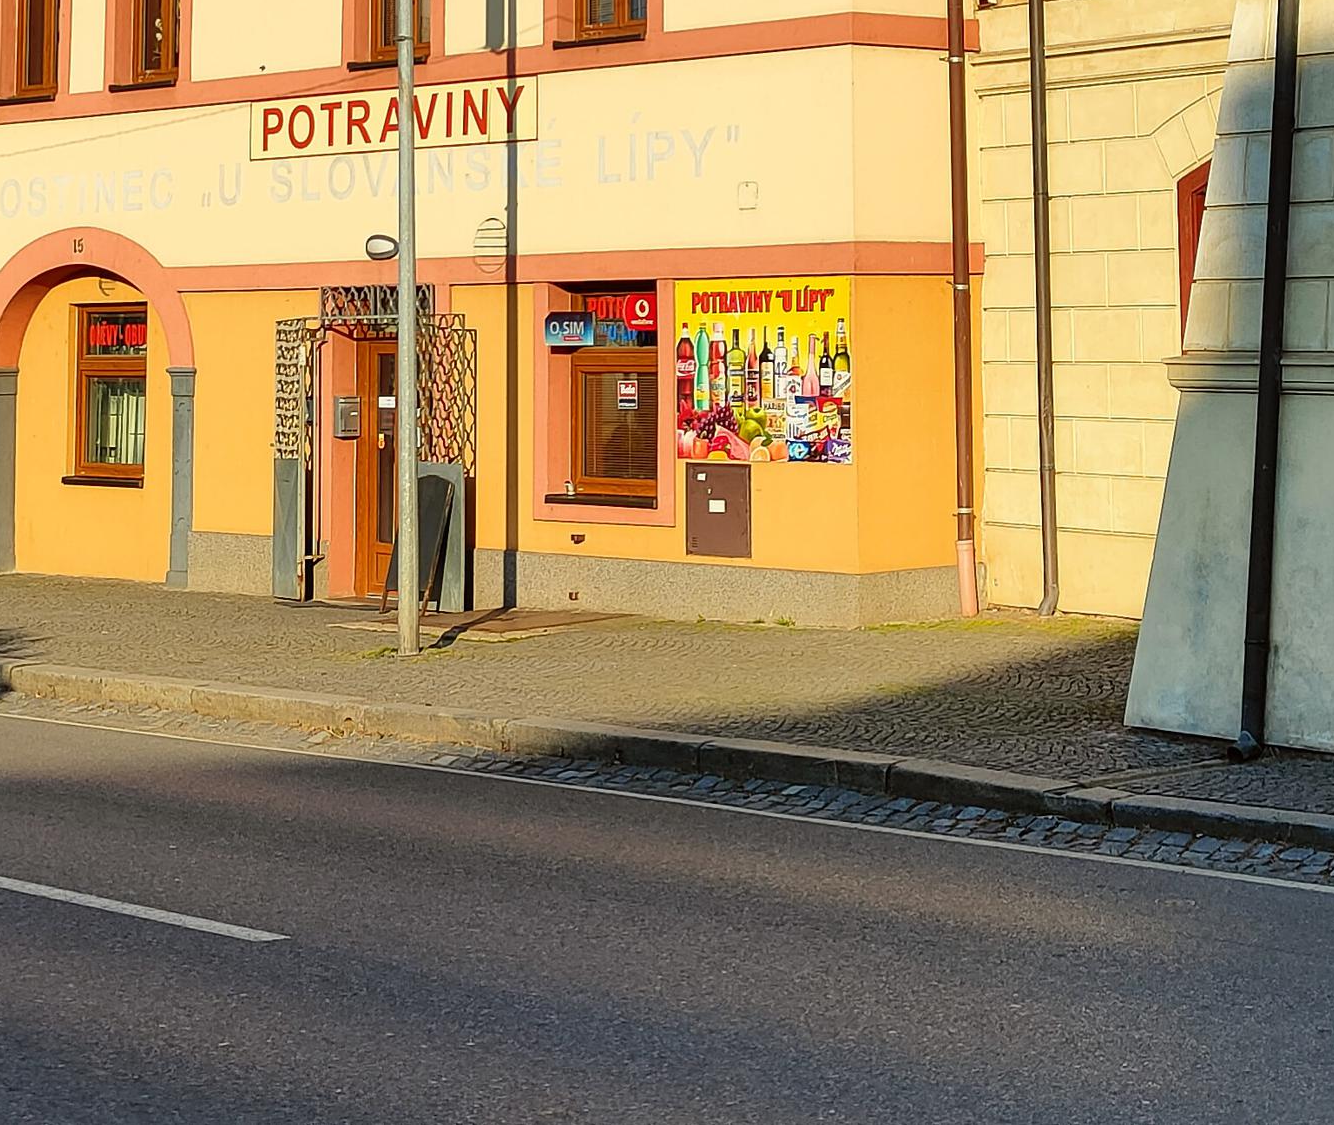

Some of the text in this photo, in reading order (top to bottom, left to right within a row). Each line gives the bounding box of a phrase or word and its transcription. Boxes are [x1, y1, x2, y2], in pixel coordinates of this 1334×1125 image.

[263, 85, 525, 151] POTRAVINY
[270, 118, 563, 203] SLOVNSKÉ
[73, 238, 84, 254] 15
[691, 288, 773, 314] POTRAVINY
[563, 321, 585, 335] SIM
